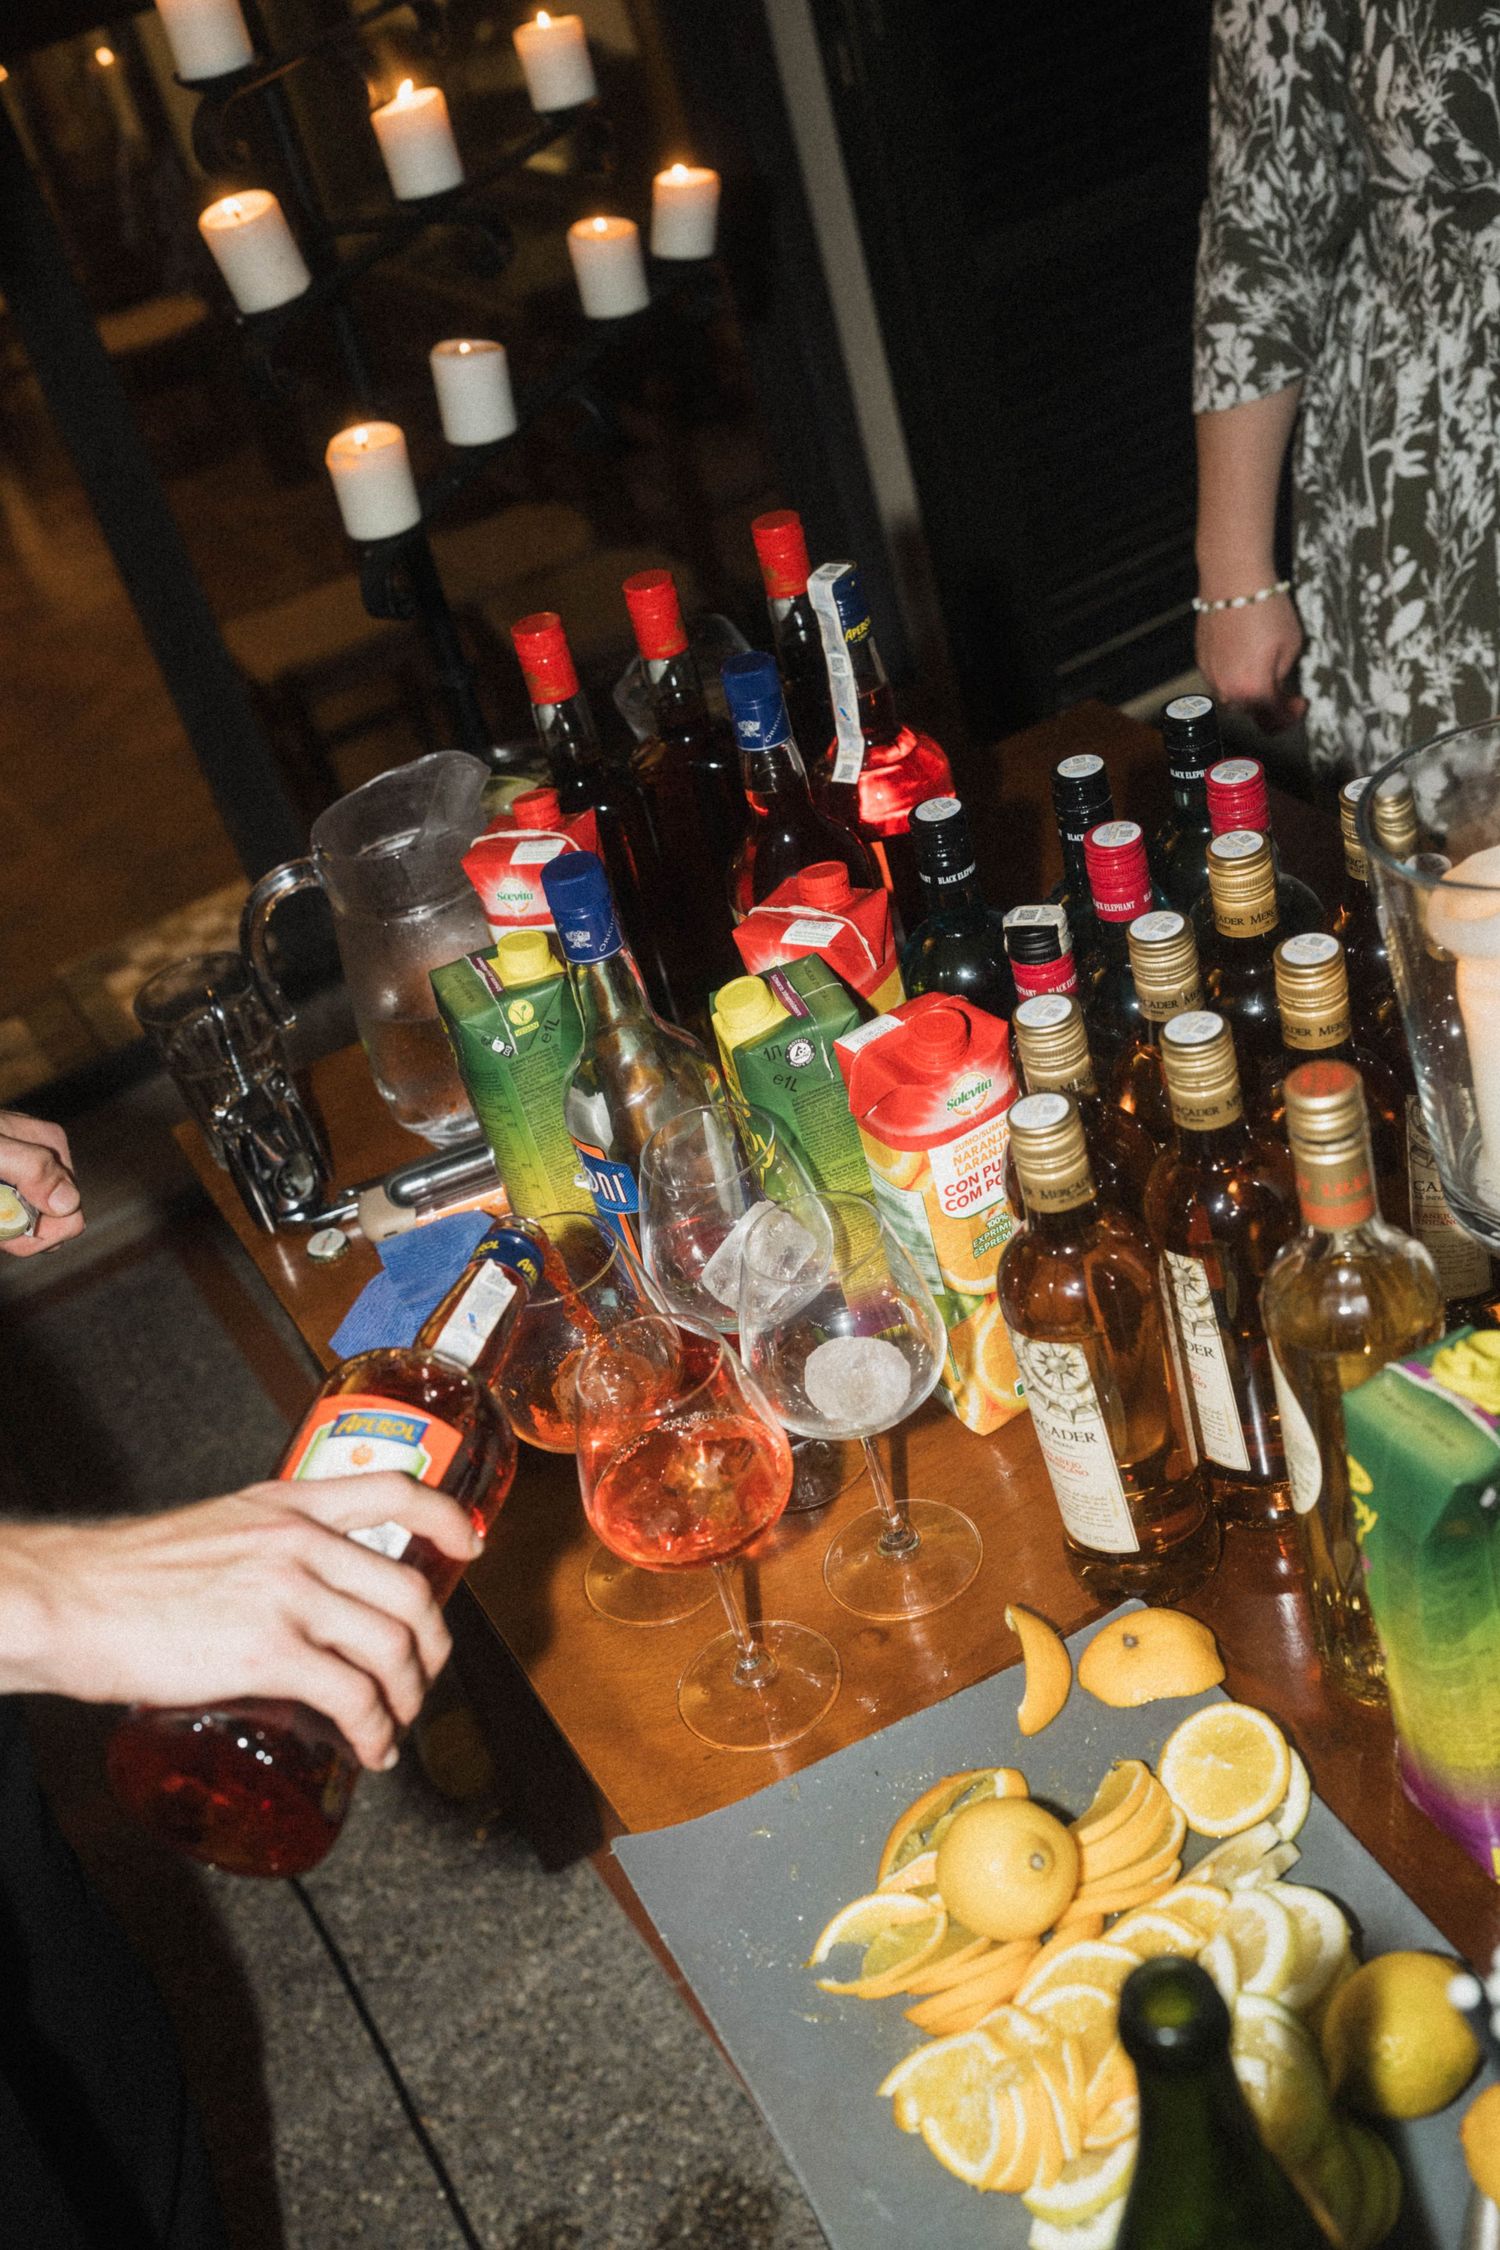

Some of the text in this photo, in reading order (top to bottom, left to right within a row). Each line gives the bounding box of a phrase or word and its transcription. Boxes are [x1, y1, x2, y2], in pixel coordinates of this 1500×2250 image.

[1104, 900, 1135, 912] ELEPHANT
[947, 1078, 992, 1111] Solevita
[953, 1127, 1010, 1166] NARANJA
[944, 1172, 979, 1197] CON
[945, 1185, 982, 1211] COM
[335, 1413, 415, 1442] APEROL
